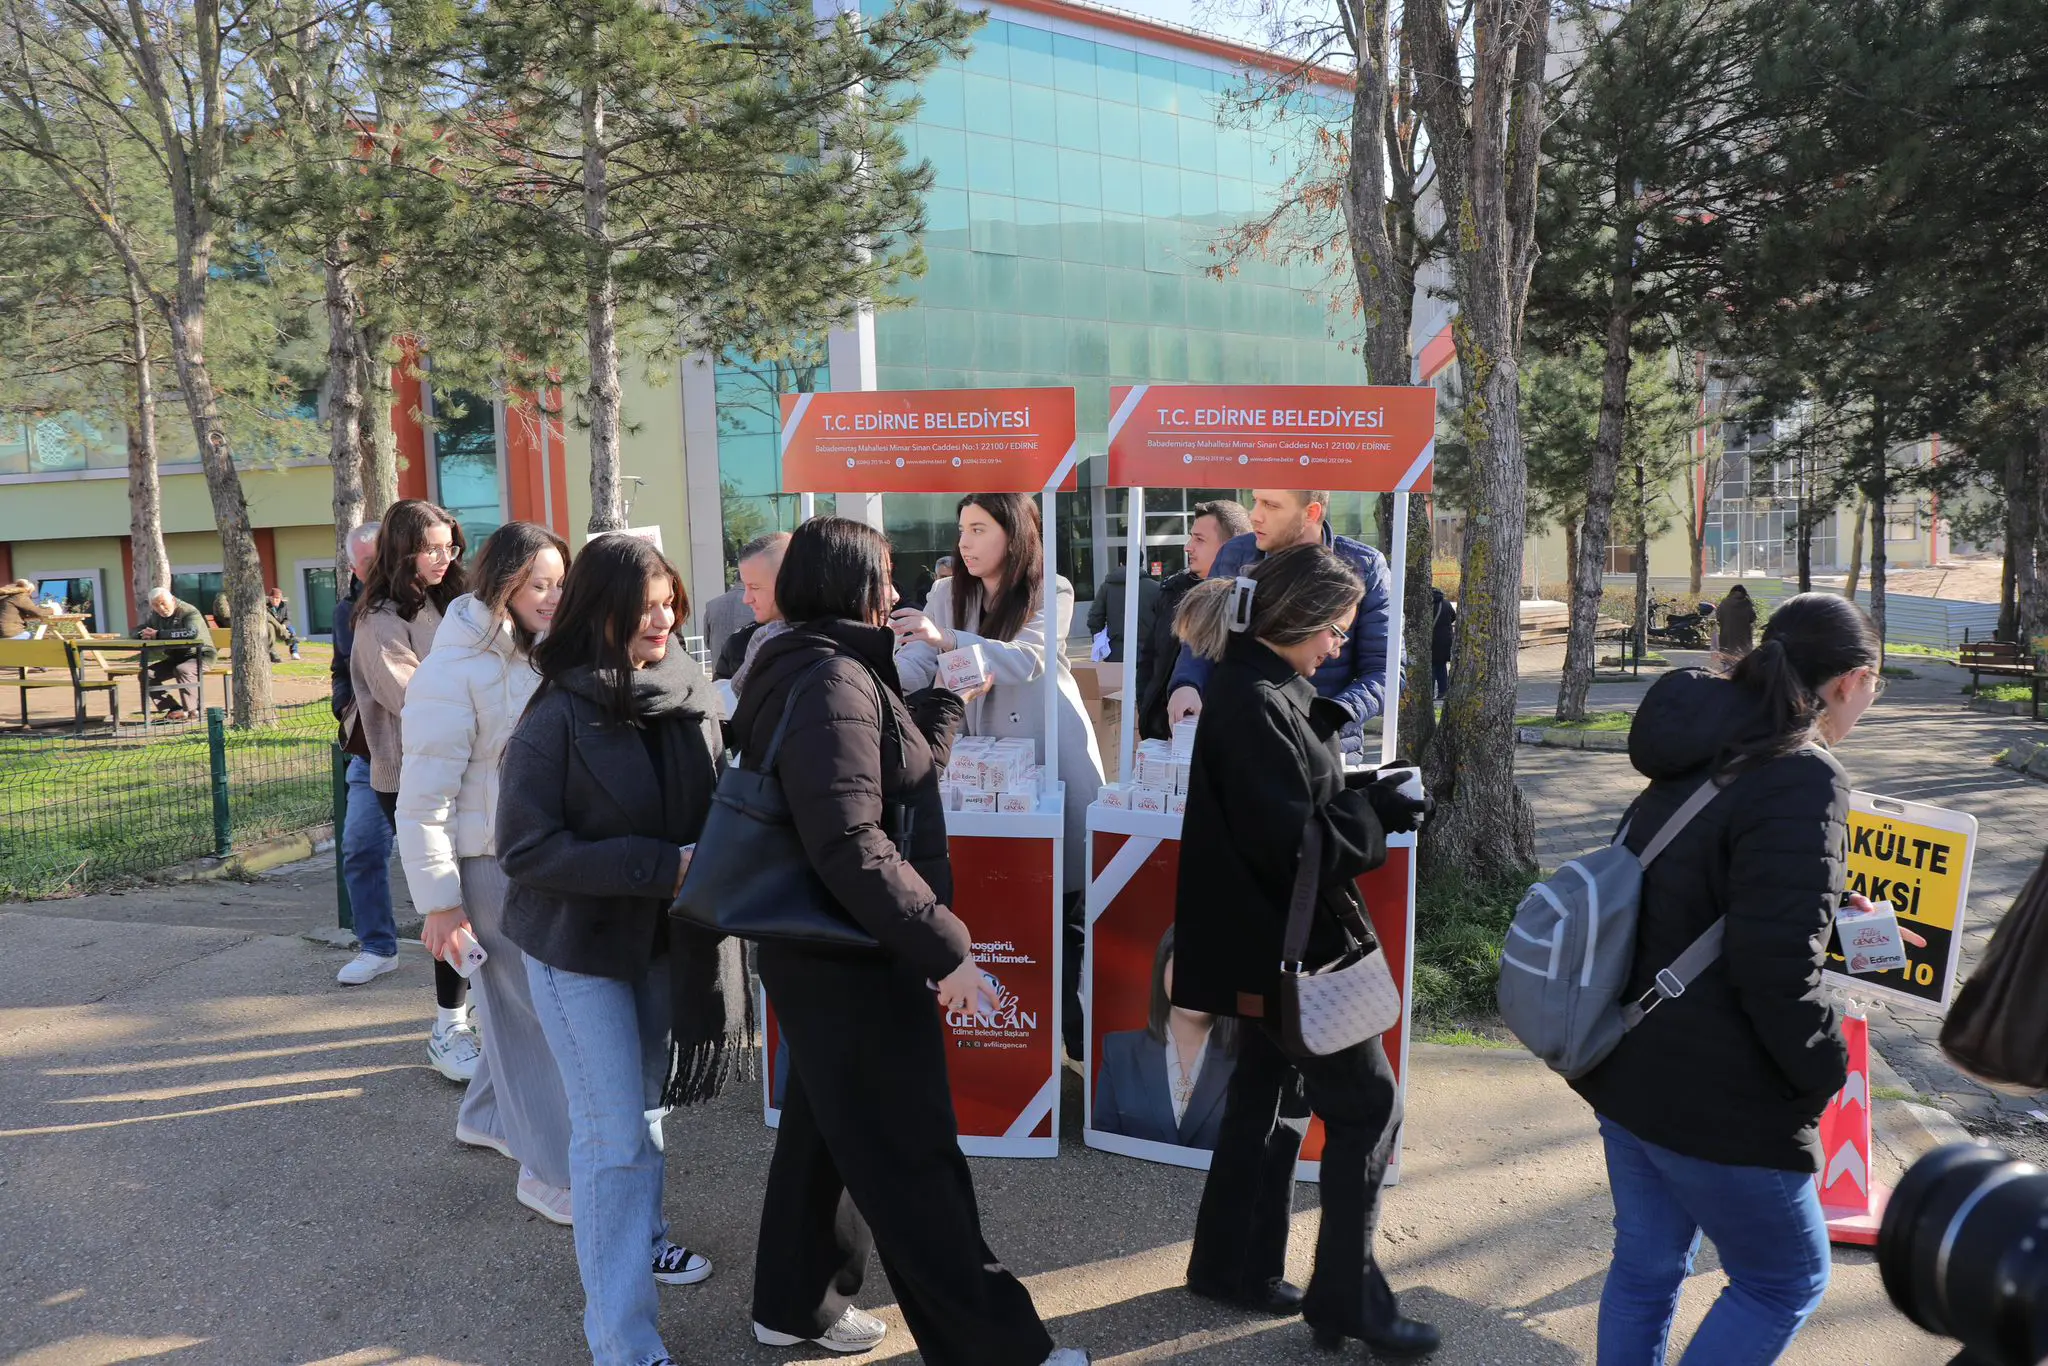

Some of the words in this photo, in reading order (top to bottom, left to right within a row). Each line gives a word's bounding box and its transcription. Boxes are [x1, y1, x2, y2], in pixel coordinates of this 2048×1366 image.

[822, 414, 850, 431] T.C.
[855, 410, 919, 430] EDİRNE
[924, 406, 1029, 429] BELEDİYESİ
[1157, 409, 1188, 425] T.C.
[1195, 405, 1266, 426] EDİRNE
[1272, 406, 1384, 428] BELEDİYESİ
[815, 444, 857, 453] Babademirtaş
[858, 444, 889, 452] Mahallesi
[889, 444, 910, 452] Mimar
[932, 443, 960, 451] Caddesi
[981, 442, 1004, 450] 22100
[1010, 442, 1038, 450] EDİRNE
[1147, 440, 1196, 448] Babademirtaş
[1197, 440, 1231, 448] Mahallesi
[1232, 441, 1255, 449] Mimar
[1279, 441, 1309, 449] Caddesi
[1331, 442, 1355, 450] 22100
[1362, 442, 1391, 450] EDİRNE
[1846, 823, 1950, 875] KÜLTE
[1852, 935, 1890, 946] GENCAN
[1869, 954, 1901, 964] Edirne
[945, 1011, 1037, 1030] GENCAN
[952, 1028, 974, 1036] Edirne
[975, 1029, 1003, 1037] Belediye
[1004, 1030, 1030, 1038] Başkanı
[983, 1041, 1027, 1050] avfilizgencan
